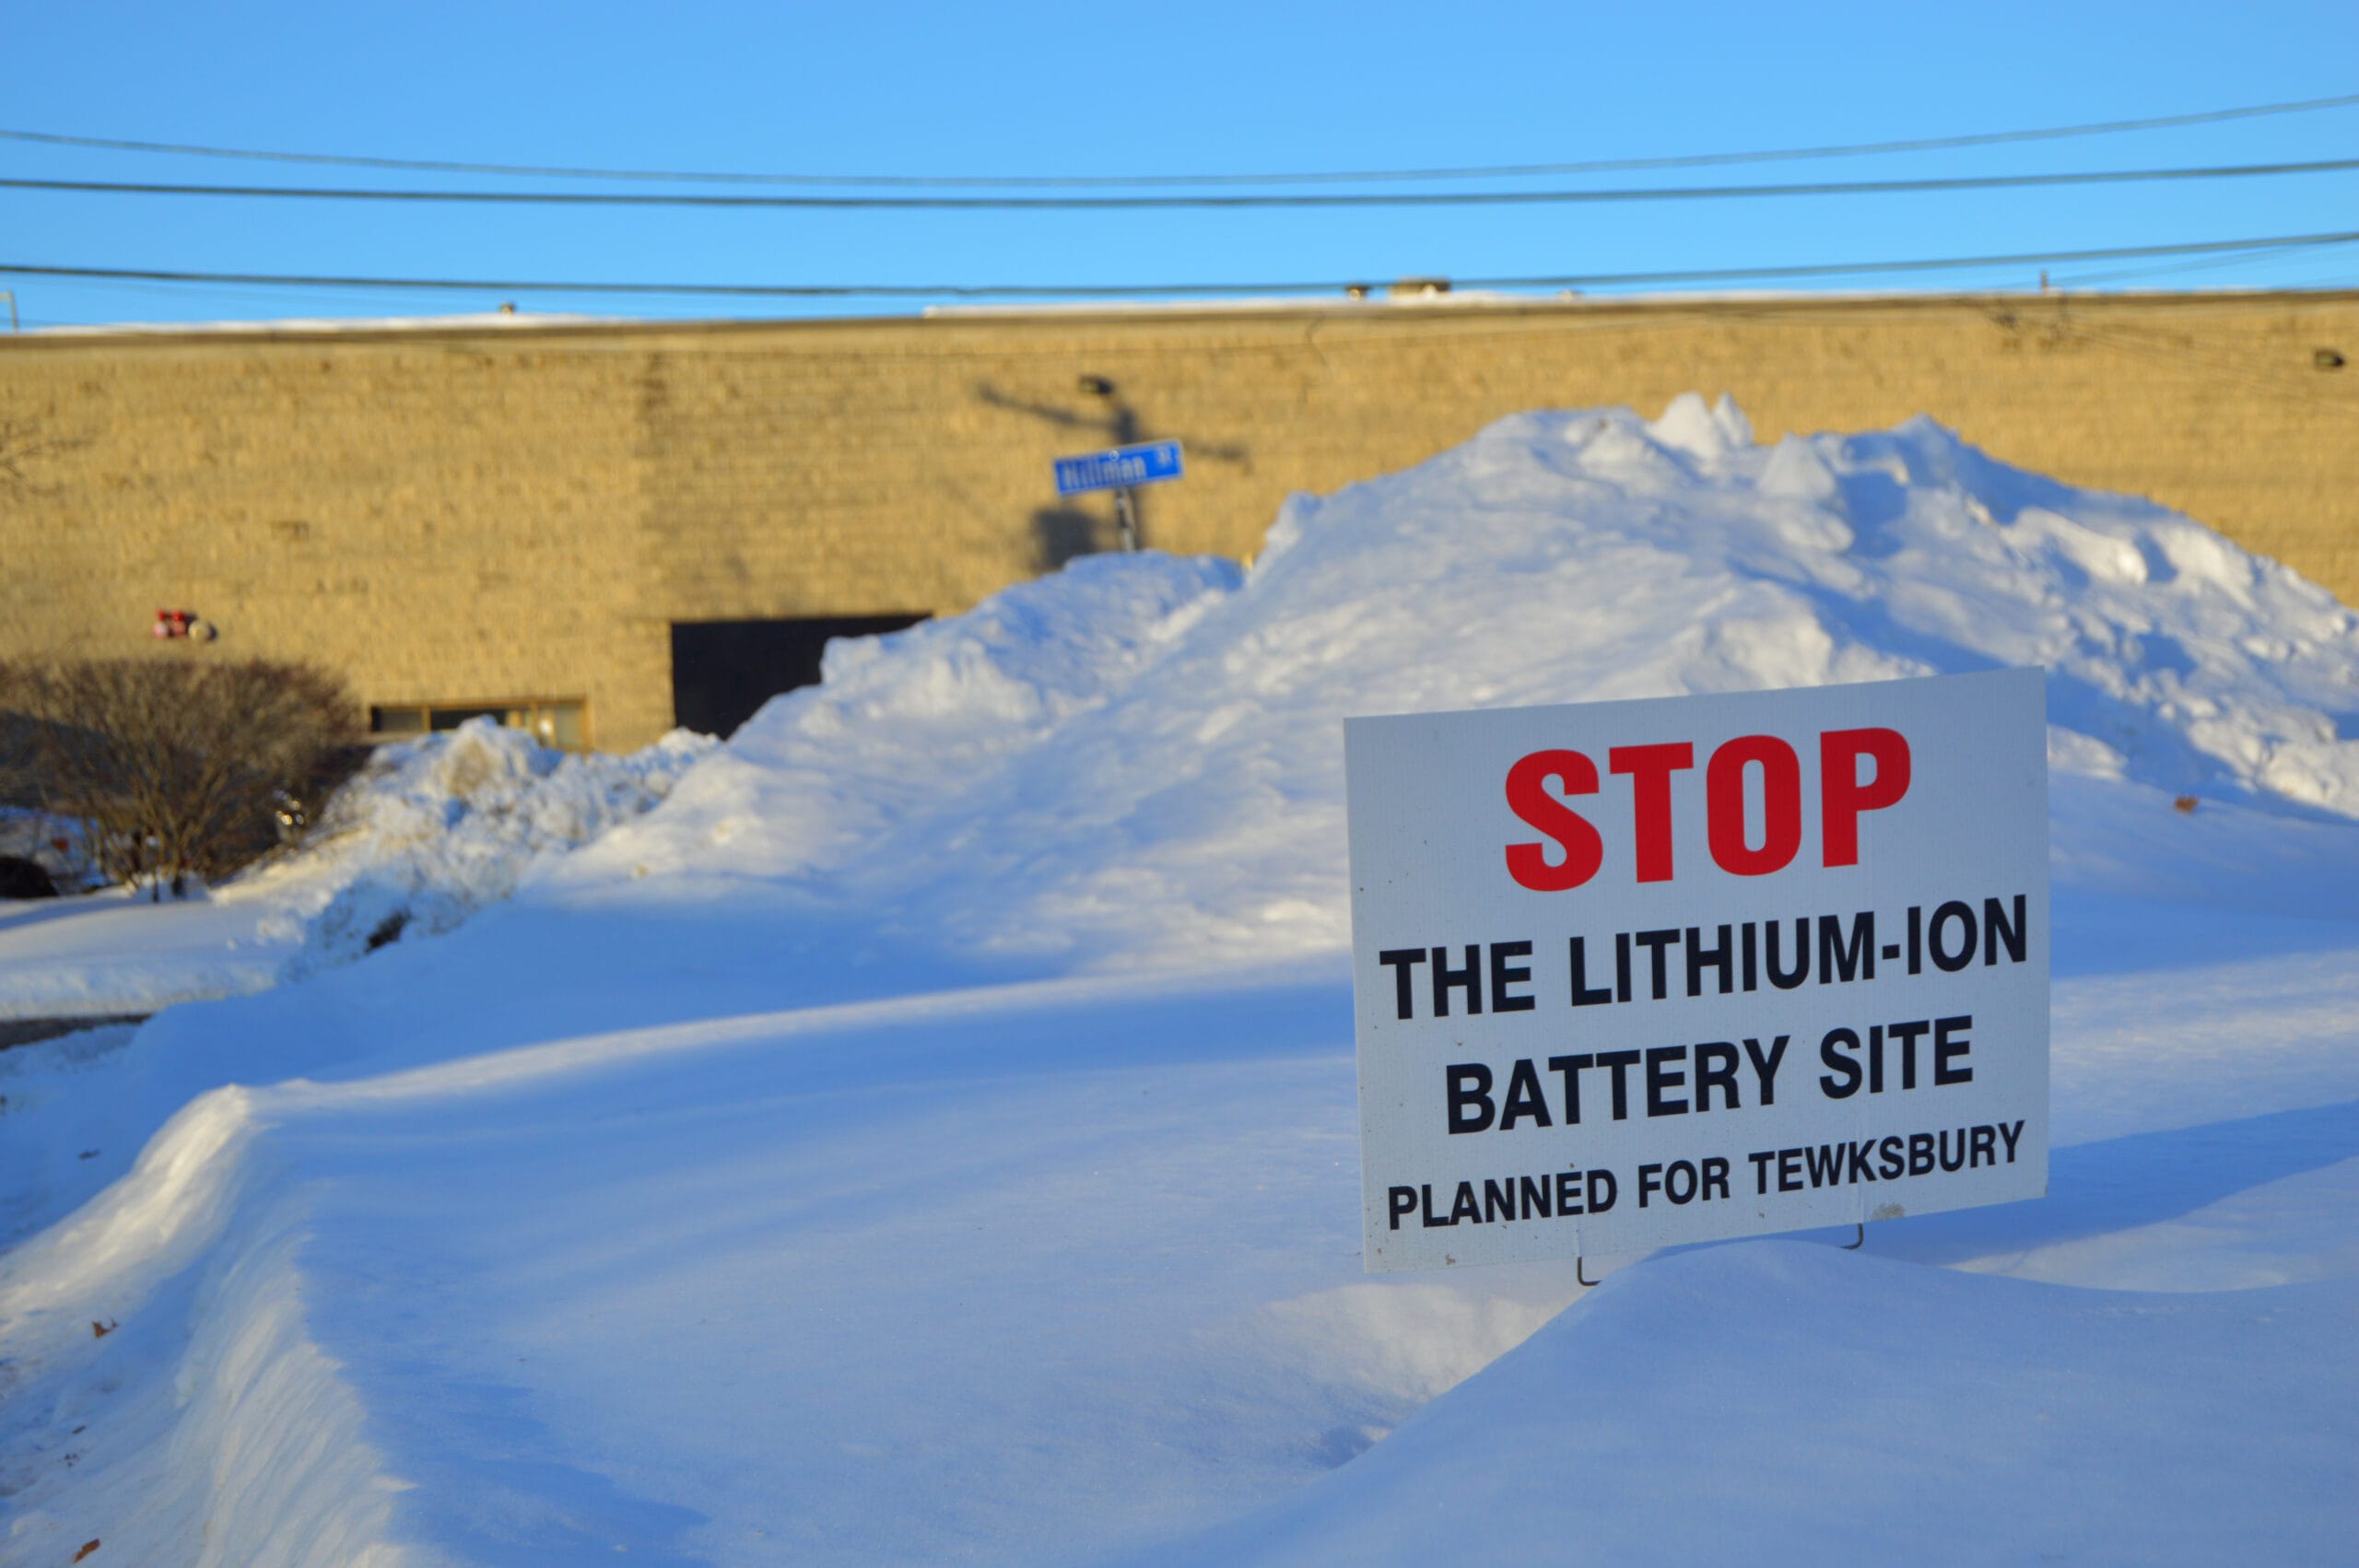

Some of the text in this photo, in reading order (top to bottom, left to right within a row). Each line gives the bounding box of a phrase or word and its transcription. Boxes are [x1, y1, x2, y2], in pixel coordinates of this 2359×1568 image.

[1506, 728, 1911, 891] STOP
[1379, 895, 2026, 1020] THE LITHIUM-ION
[1447, 1015, 1974, 1135] BATTERY SITE
[1389, 1120, 2025, 1231] PLANNED FOR TEWKSBURY
